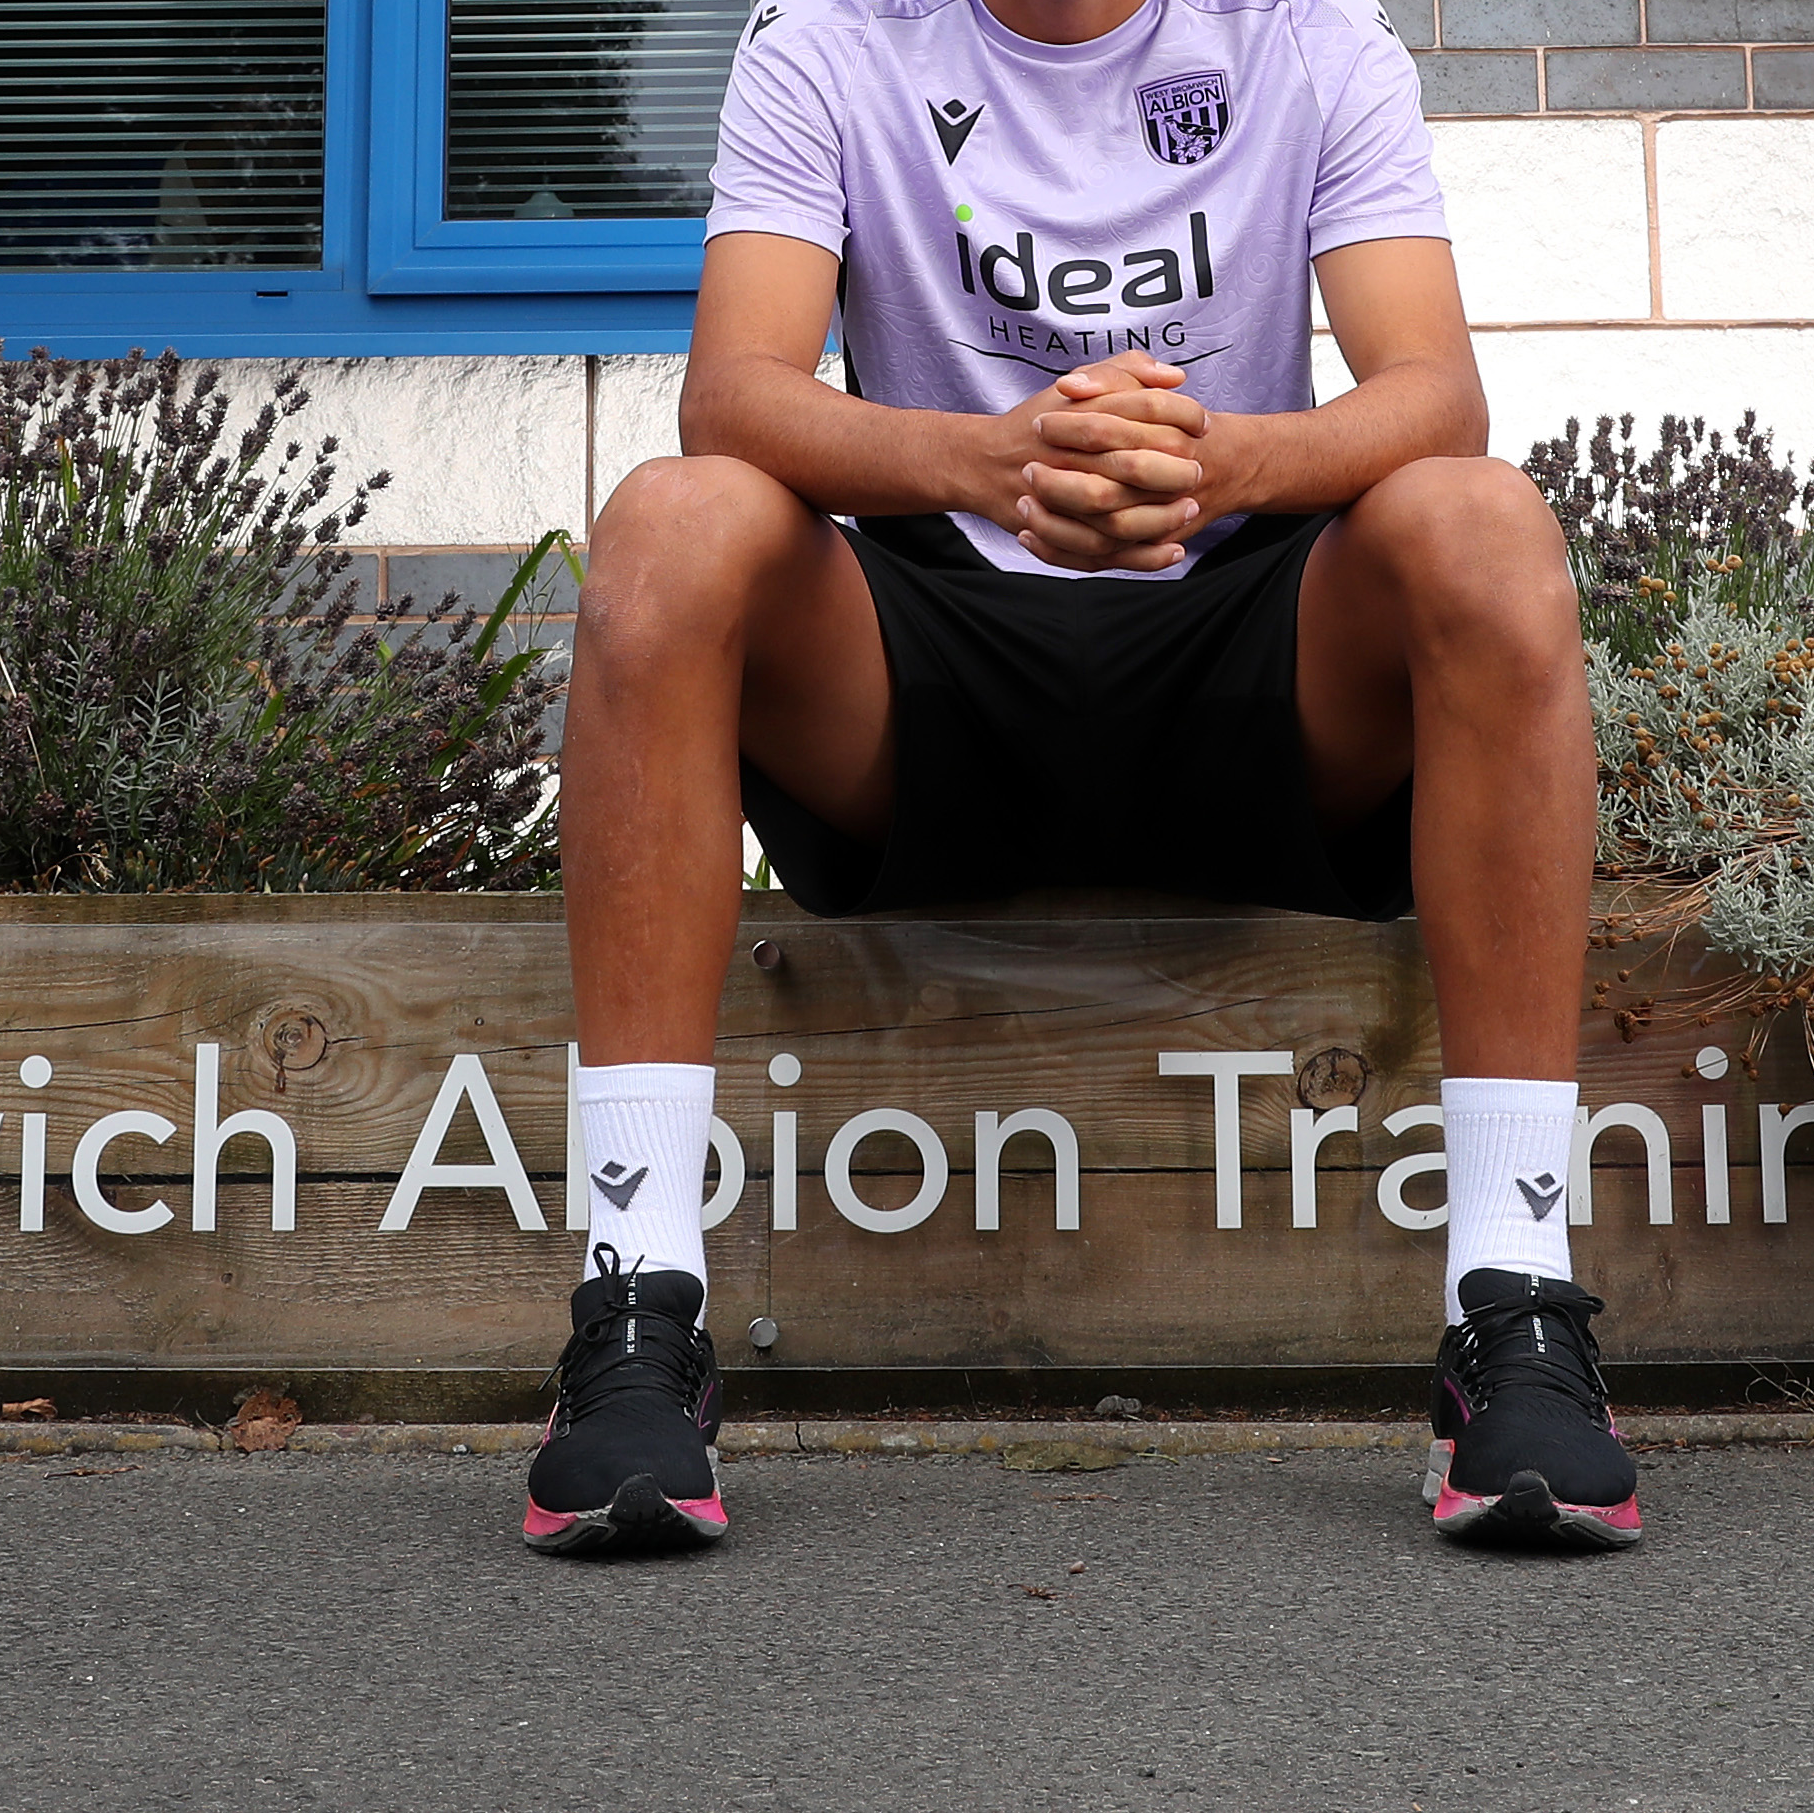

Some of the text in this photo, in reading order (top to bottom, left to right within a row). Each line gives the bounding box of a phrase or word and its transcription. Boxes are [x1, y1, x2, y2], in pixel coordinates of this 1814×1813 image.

[1145, 88, 1169, 100] WEST
[1149, 85, 1221, 116] ALBION
[955, 204, 1214, 316] ideal
[989, 316, 1186, 355] HEATING
